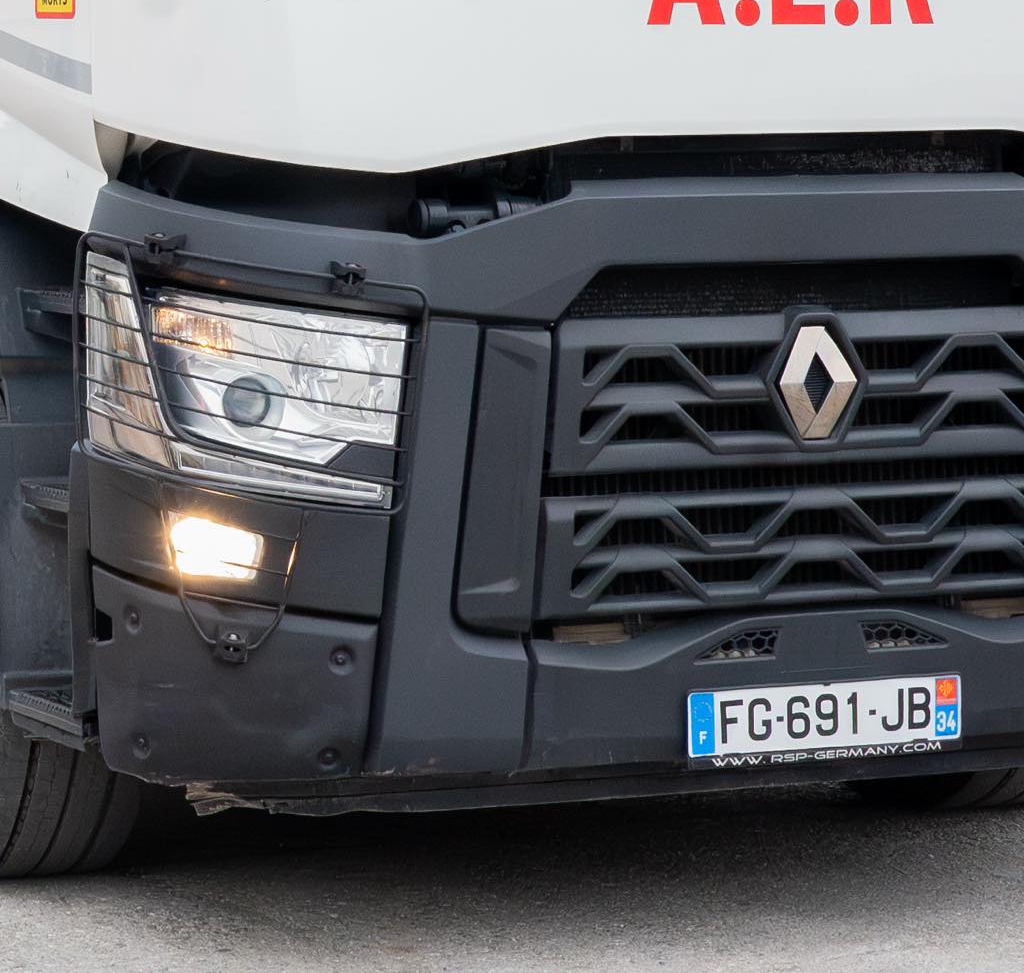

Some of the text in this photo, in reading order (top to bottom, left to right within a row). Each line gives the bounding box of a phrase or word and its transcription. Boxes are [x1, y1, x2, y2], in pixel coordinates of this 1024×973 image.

[719, 686, 931, 745] FG-691-JB
[936, 710, 957, 733] 34
[699, 730, 708, 745] F
